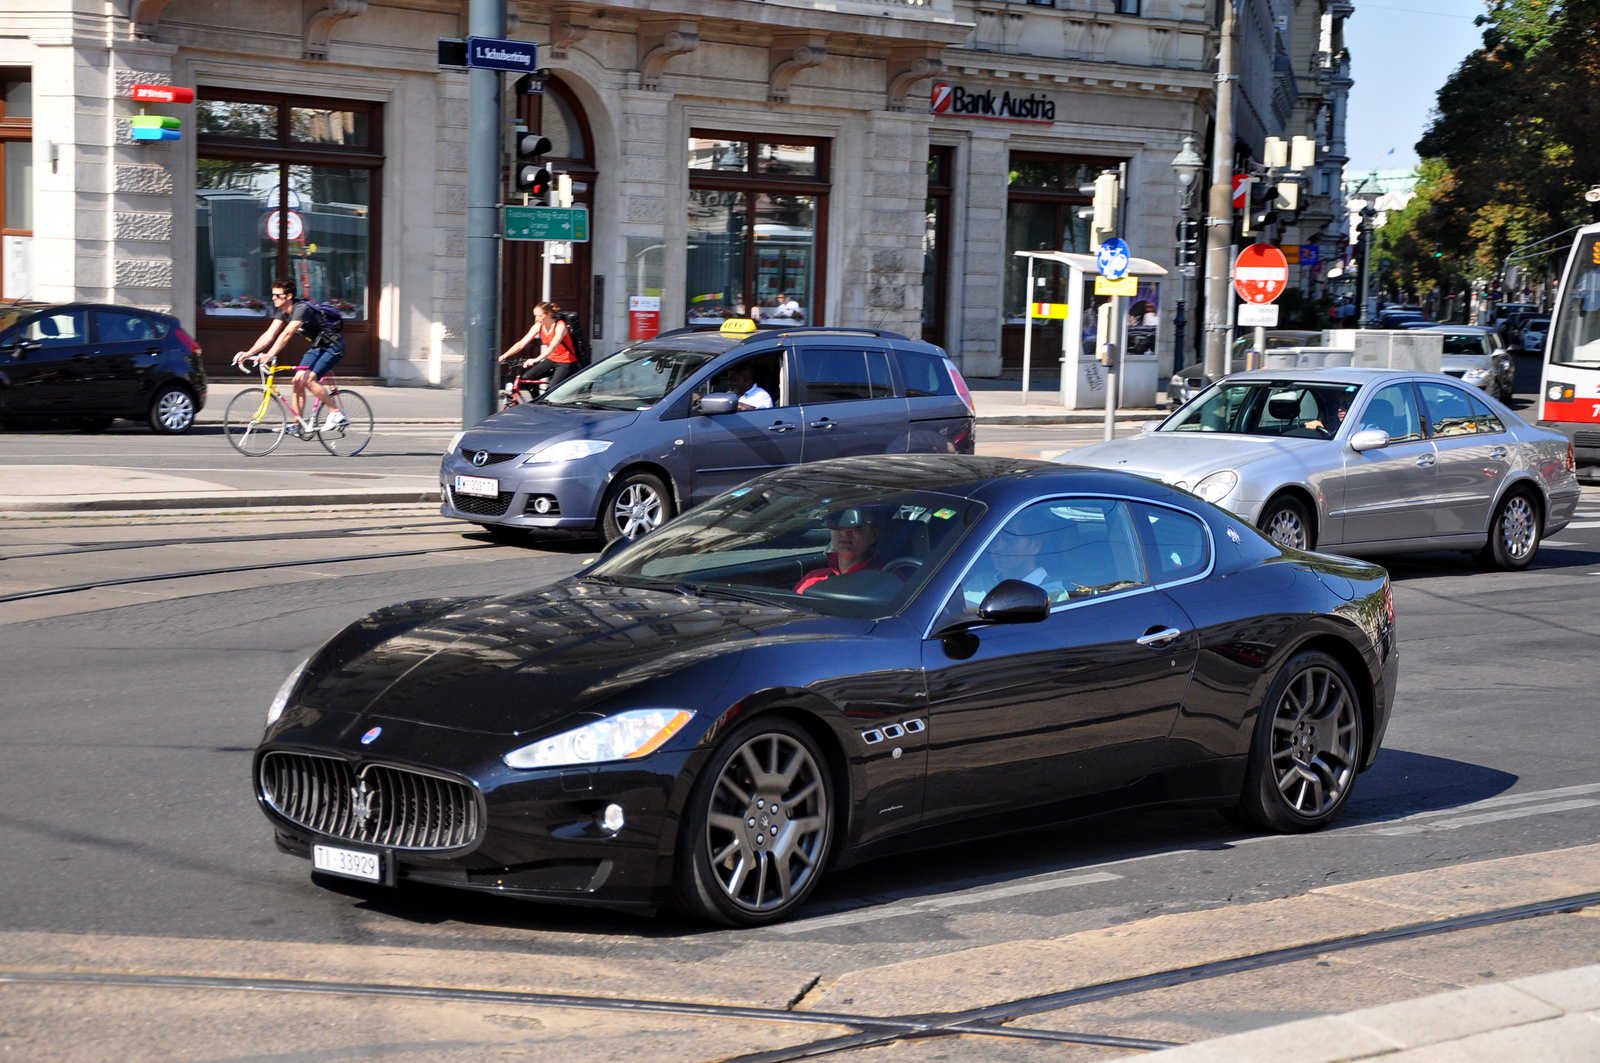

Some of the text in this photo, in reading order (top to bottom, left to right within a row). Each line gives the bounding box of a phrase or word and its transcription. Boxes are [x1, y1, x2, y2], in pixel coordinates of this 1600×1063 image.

[485, 47, 531, 65] Schubertring
[953, 86, 1055, 119] Bank Austria
[724, 321, 746, 330] TAXI
[339, 852, 375, 875] 33929
